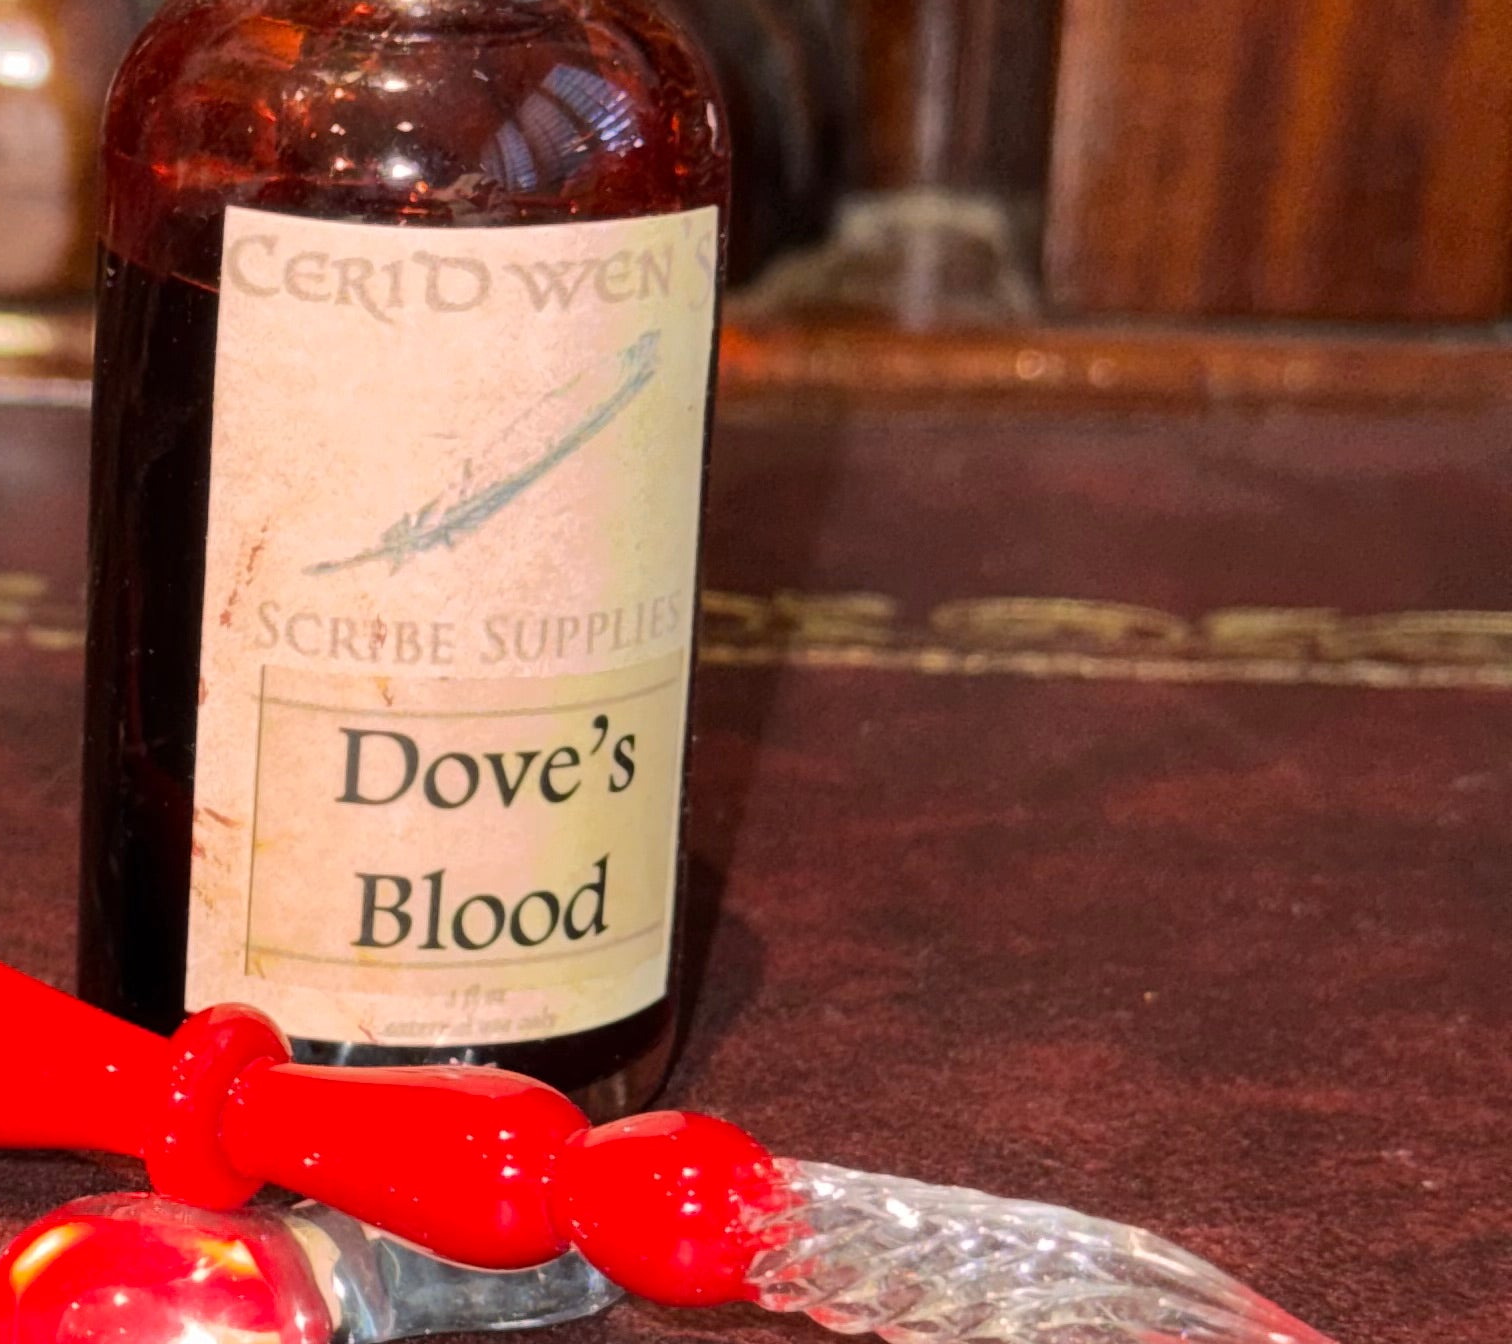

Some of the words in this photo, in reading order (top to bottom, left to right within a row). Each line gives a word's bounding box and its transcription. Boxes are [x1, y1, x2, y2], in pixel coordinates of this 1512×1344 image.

[254, 600, 457, 665] SCRIBE
[479, 590, 682, 664] SUPPLIES
[335, 714, 637, 809] Dove's
[351, 852, 610, 951] Blood
